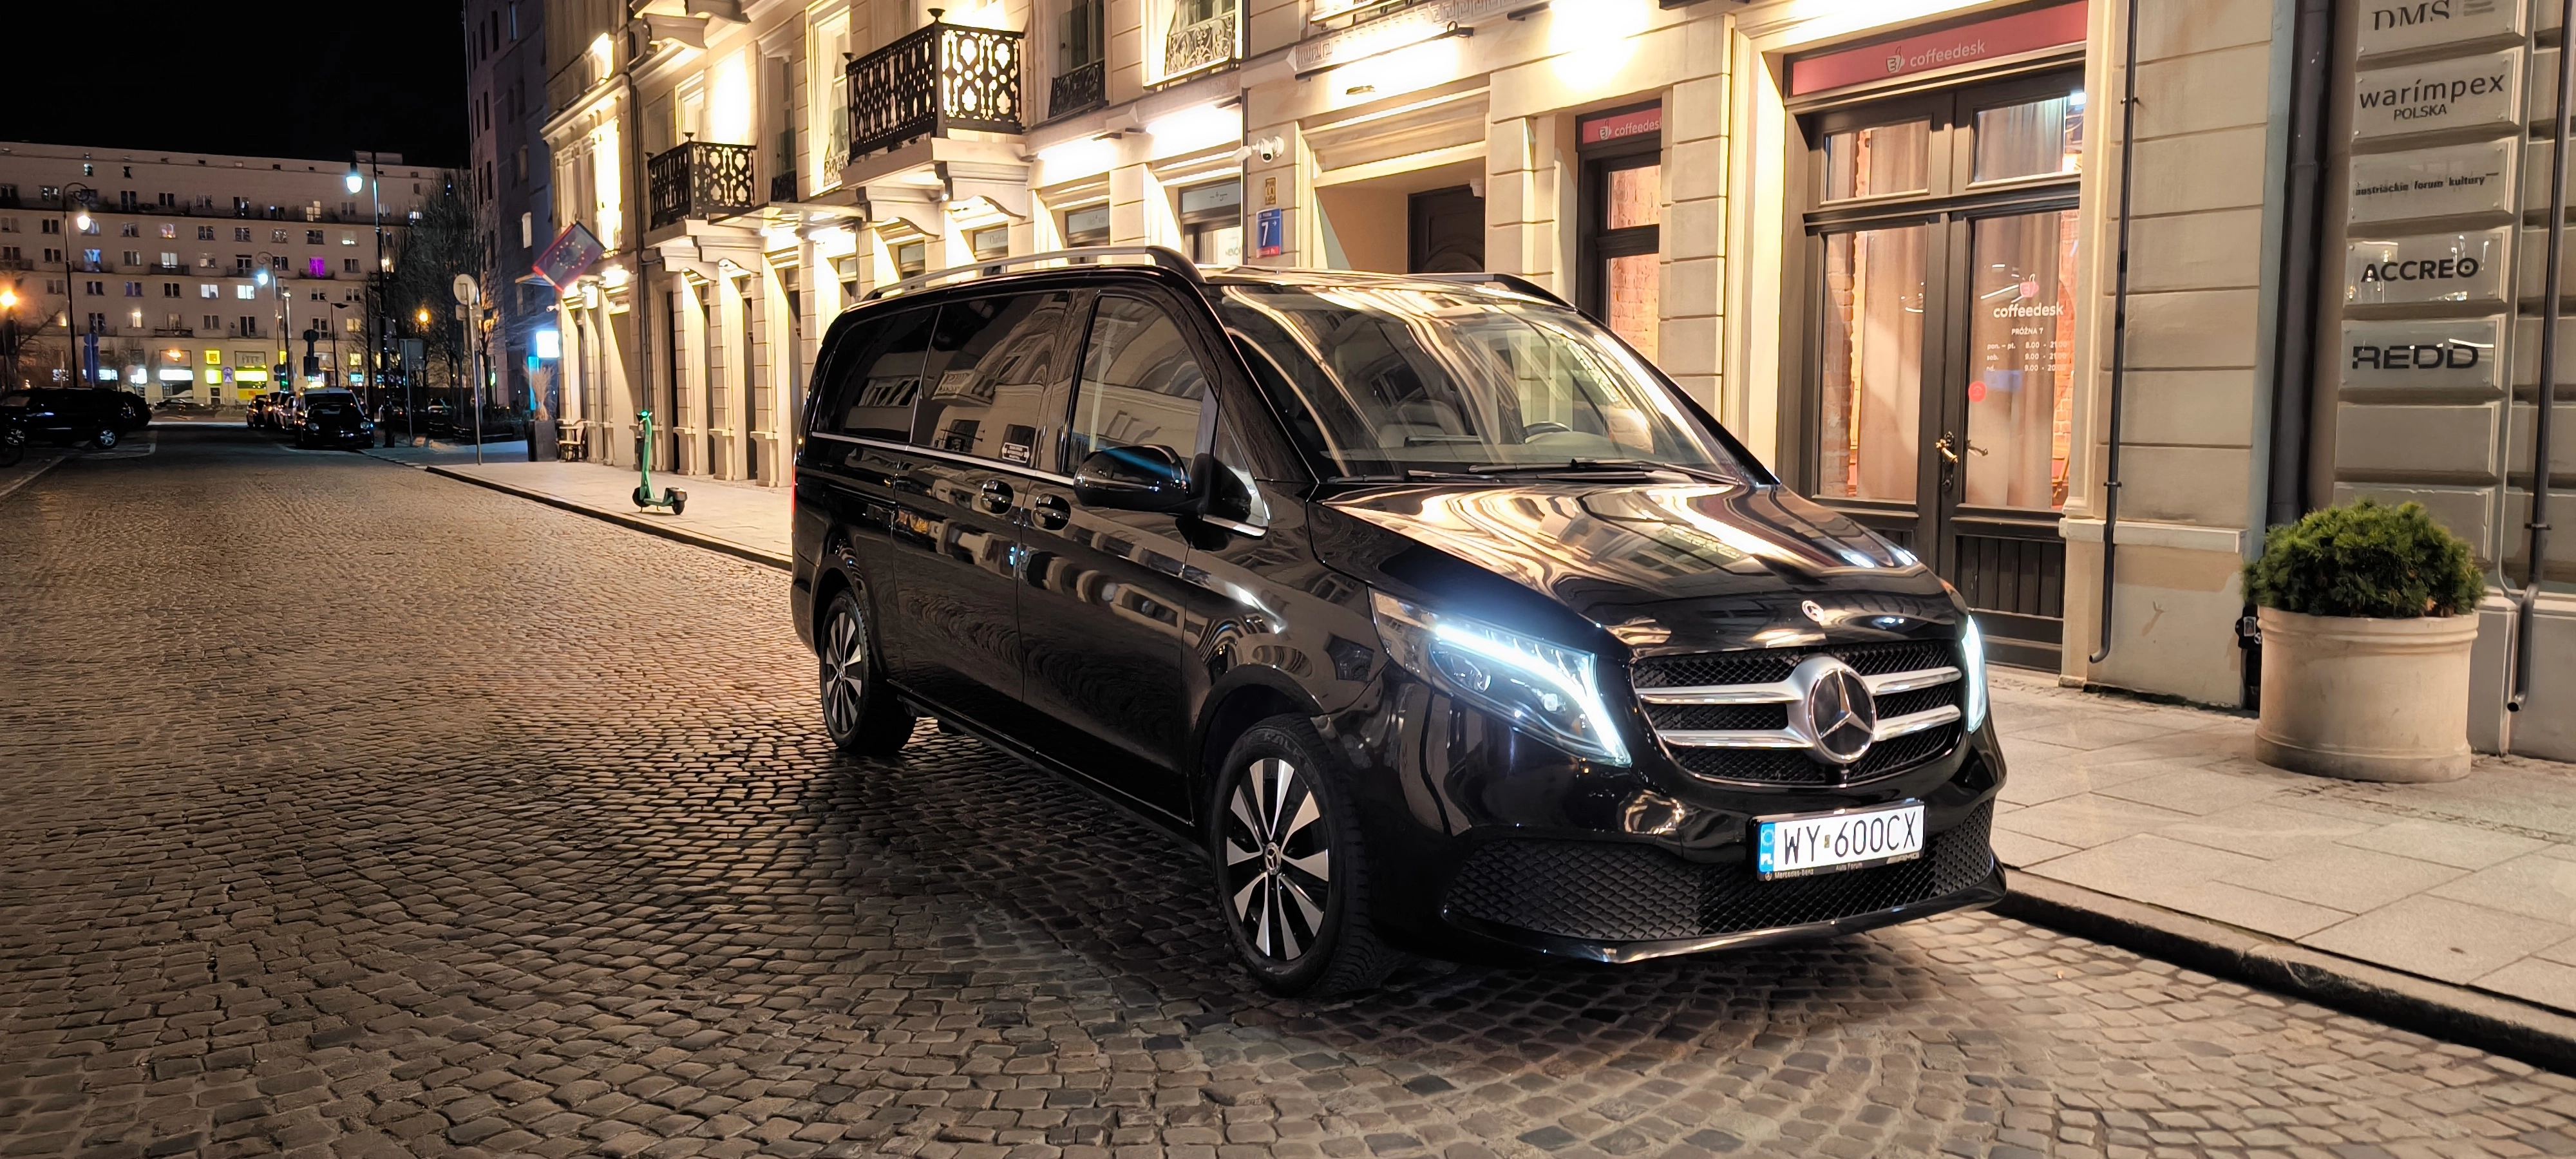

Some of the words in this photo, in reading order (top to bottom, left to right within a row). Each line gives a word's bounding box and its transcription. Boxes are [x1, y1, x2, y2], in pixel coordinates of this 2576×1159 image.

[2372, 0, 2450, 31] DMS
[1909, 39, 1985, 67] coffeedesk
[2393, 104, 2447, 122] POLSKA
[2414, 180, 2444, 190] forum
[2448, 175, 2486, 186] kultury
[1262, 221, 1269, 246] 7
[2361, 258, 2479, 283] ACCREO
[1993, 301, 2064, 318] coffeedesk
[2011, 326, 2038, 335] PRÓŻNA
[2352, 344, 2479, 370] REDD
[1784, 825, 1821, 865] WY
[1835, 811, 1916, 858] 600CX
